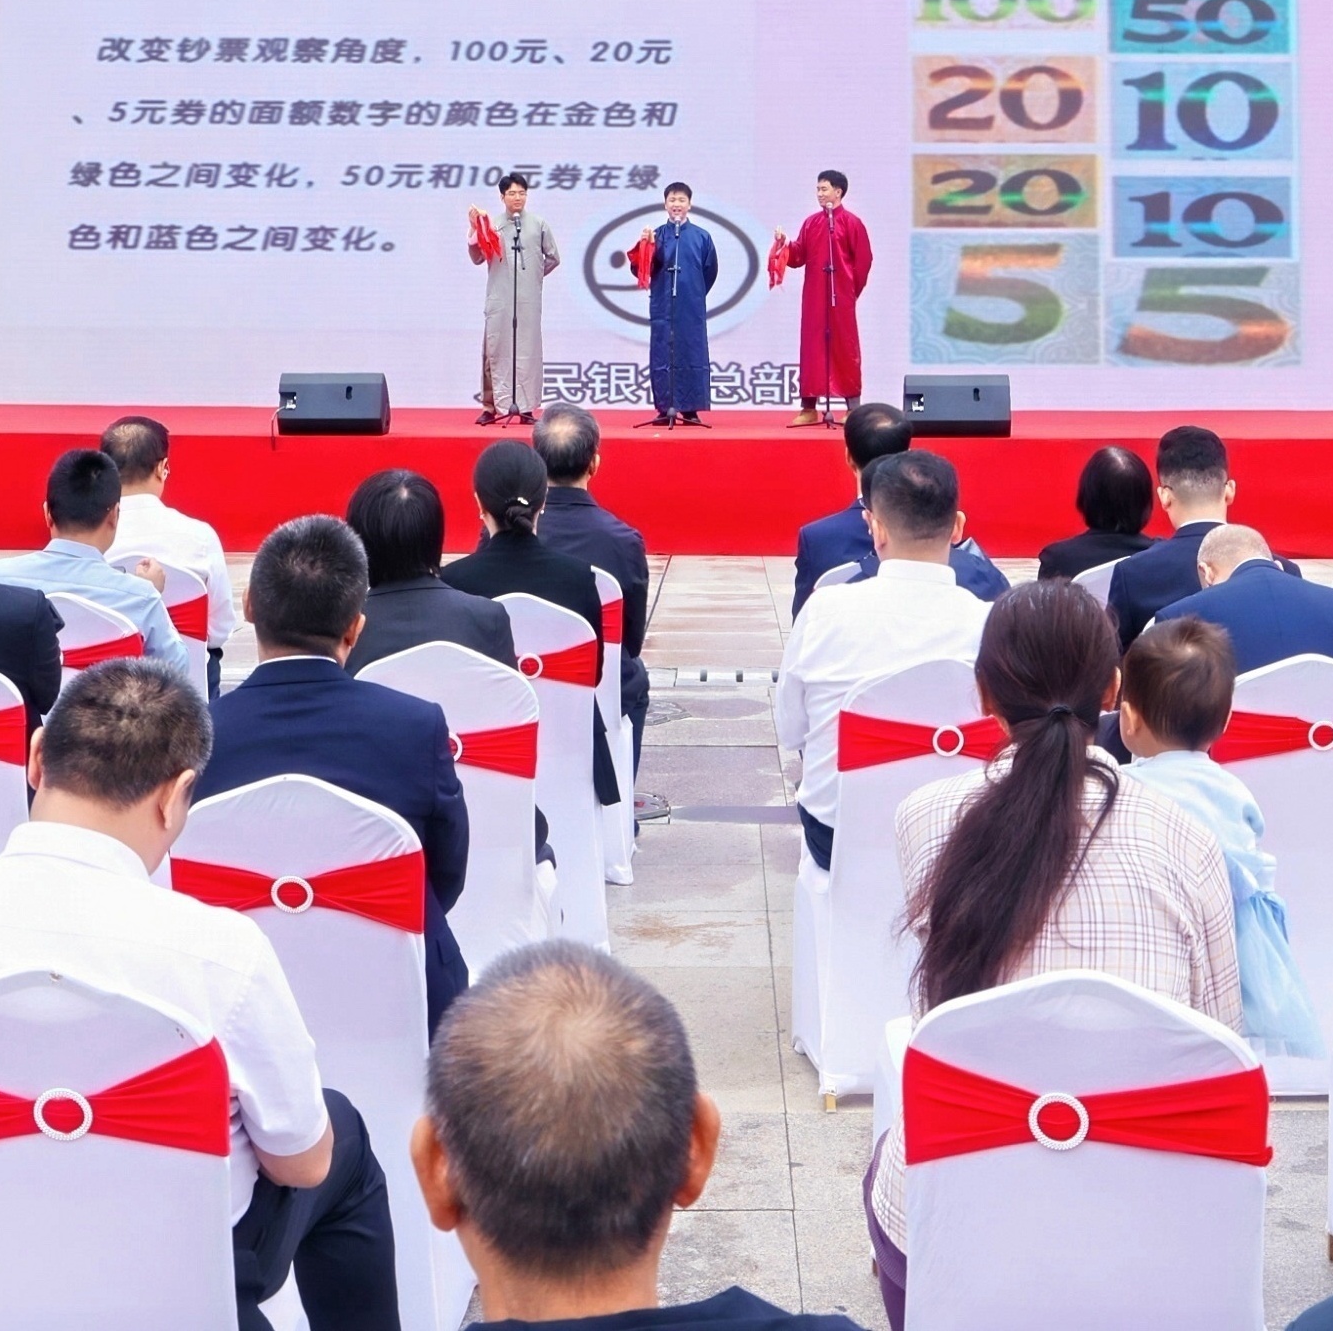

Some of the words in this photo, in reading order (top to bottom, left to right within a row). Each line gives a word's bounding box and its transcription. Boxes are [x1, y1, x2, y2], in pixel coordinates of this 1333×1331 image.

[926, 64, 1084, 131] 20
[1123, 70, 1280, 153] 10
[926, 167, 1086, 216] 20
[1128, 189, 1285, 249] 10
[68, 223, 401, 254] 色和蓝色之间变化。
[943, 241, 1065, 346] 5
[1118, 266, 1292, 366] 5
